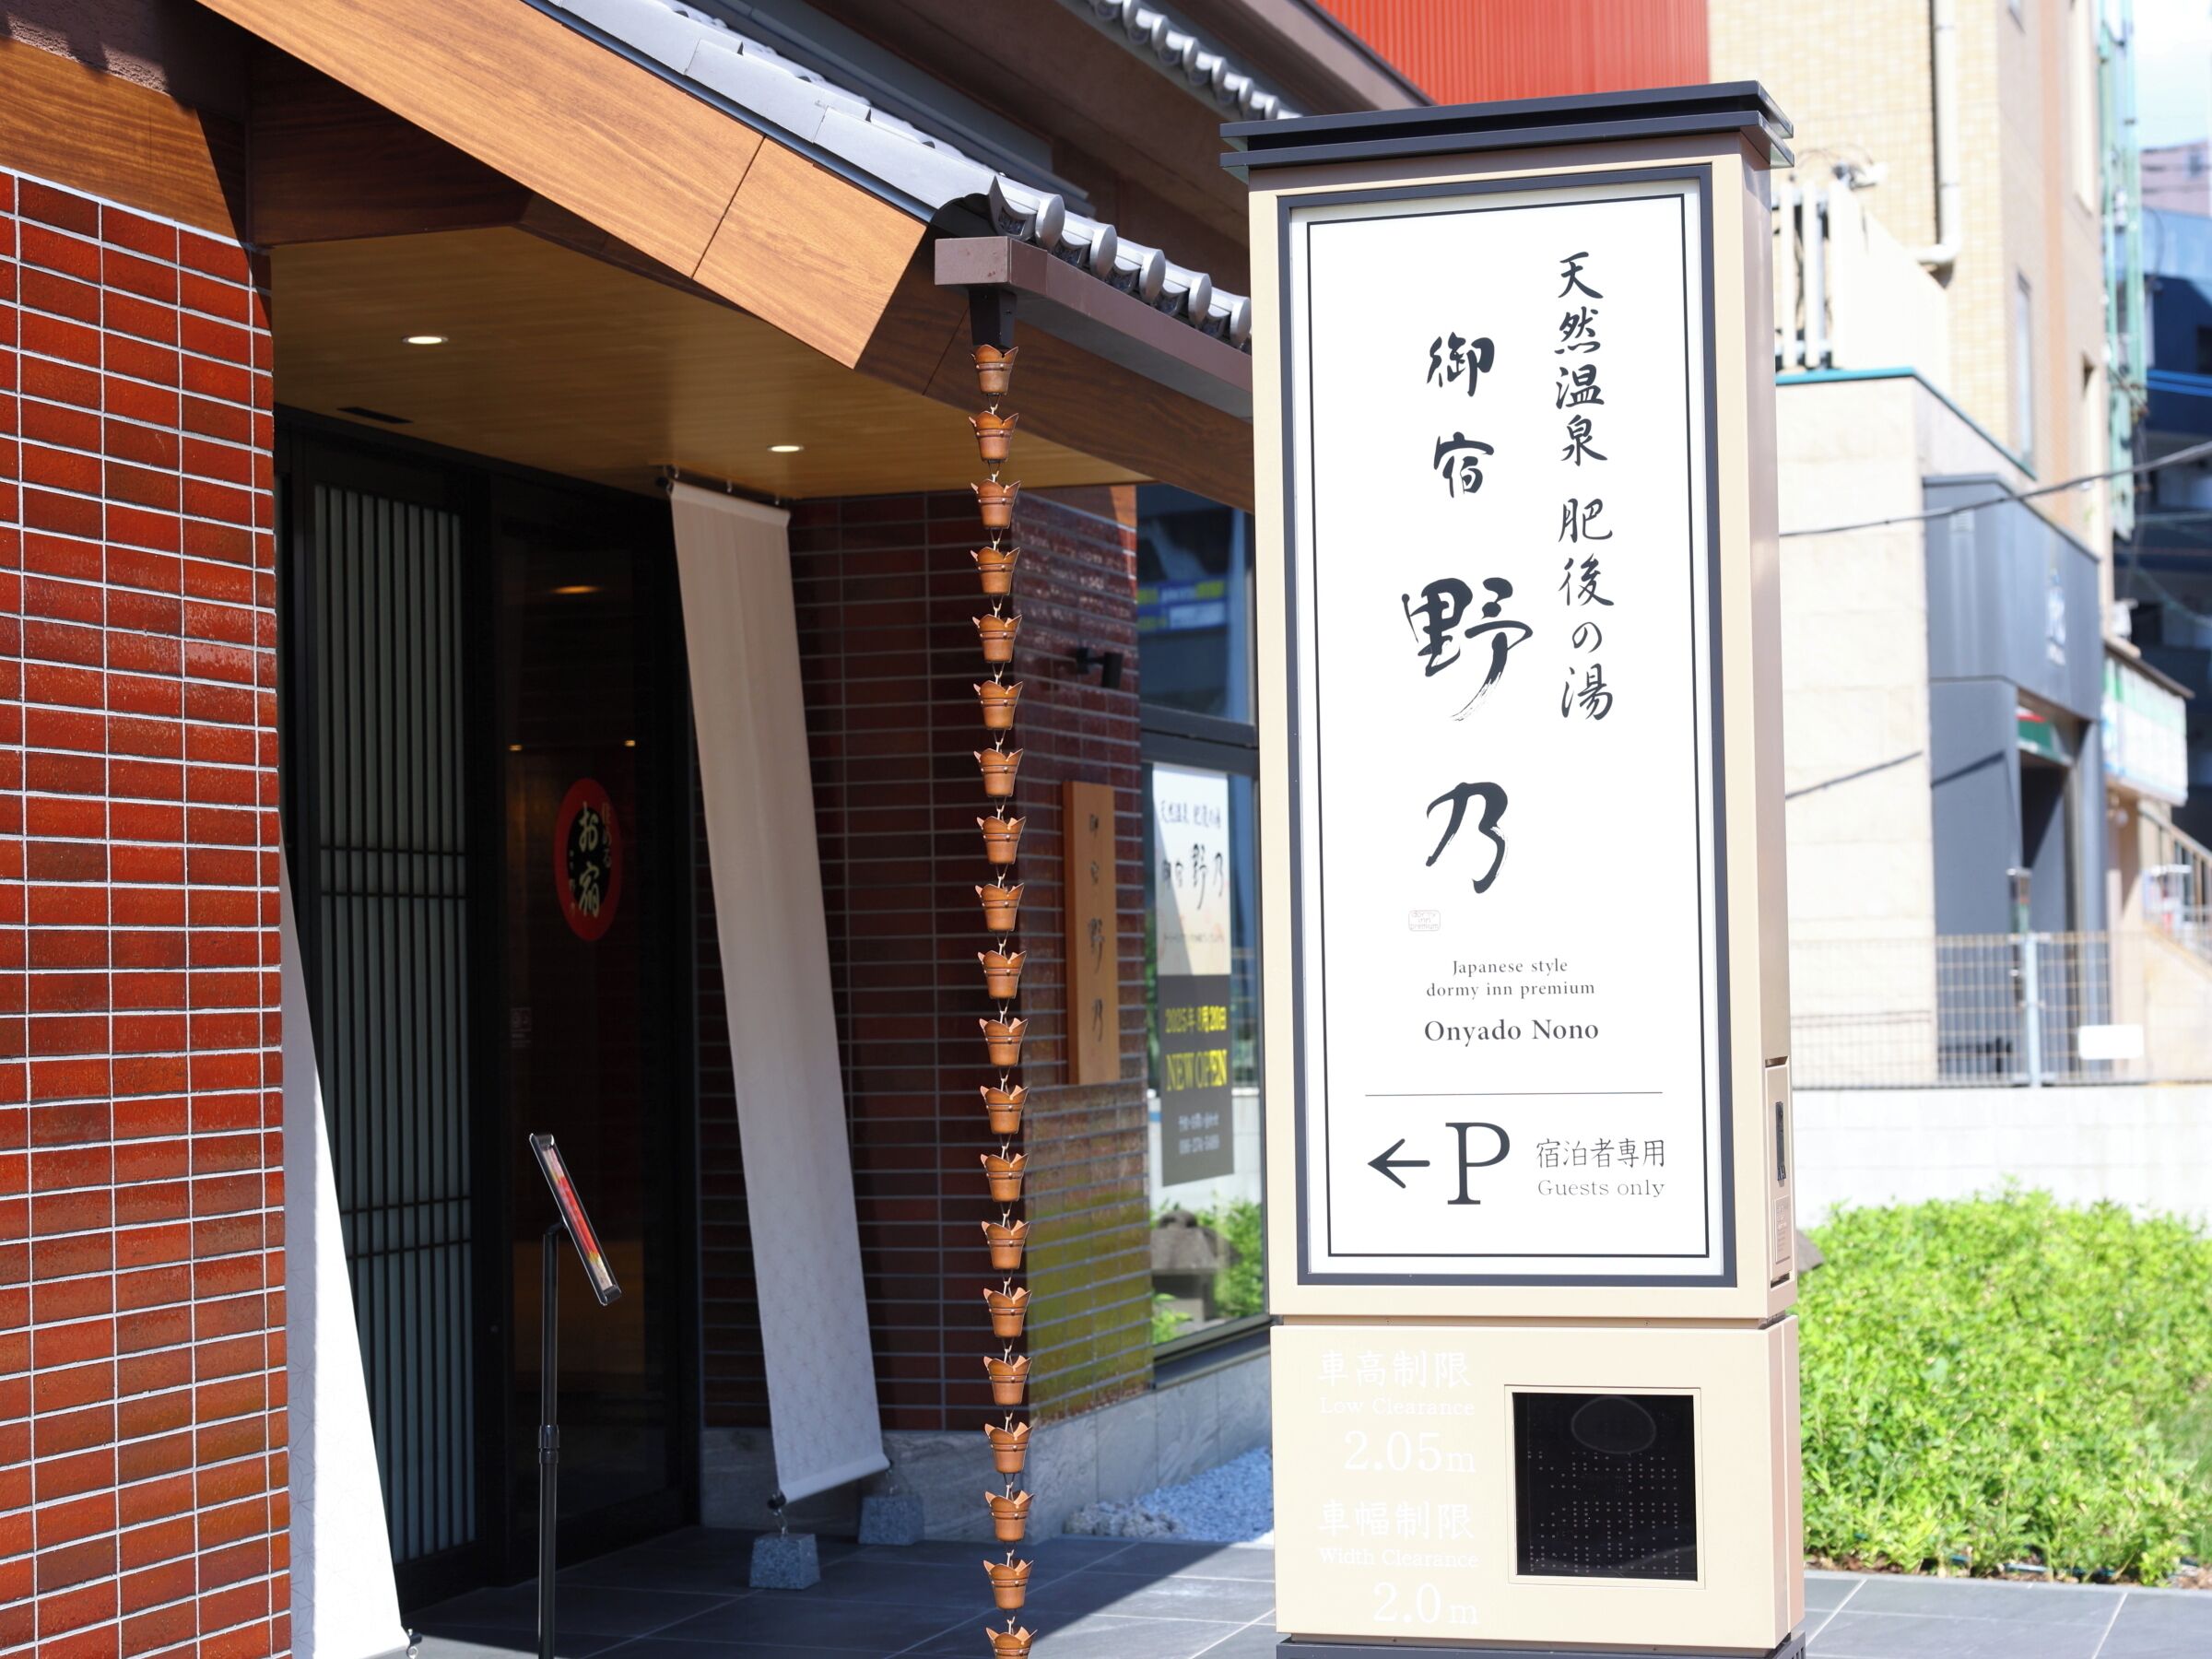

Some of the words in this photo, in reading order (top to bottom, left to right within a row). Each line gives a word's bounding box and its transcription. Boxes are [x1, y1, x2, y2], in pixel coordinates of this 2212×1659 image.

[1555, 252, 1608, 467] 天然温泉
[1402, 331, 1533, 894] 御宿野乃
[1558, 499, 1614, 721] 肥後の湯
[1453, 960, 1524, 977] Japanese
[1531, 958, 1568, 976] style
[1426, 982, 1478, 1000] dormy
[1487, 982, 1512, 996] inn
[1521, 982, 1594, 999] premium
[1424, 1018, 1522, 1047] Onyado
[1532, 1018, 1599, 1040] Nono
[1445, 1122, 1511, 1205] P
[1536, 1137, 1665, 1169] 宿泊者専用
[1537, 1180, 1609, 1196] Guests
[1617, 1179, 1665, 1198] only
[1317, 1349, 1473, 1388] 車高制限
[1372, 1397, 1475, 1416] Clearance
[1317, 1499, 1475, 1540] 車幅制限
[1381, 1548, 1480, 1569] Clearance
